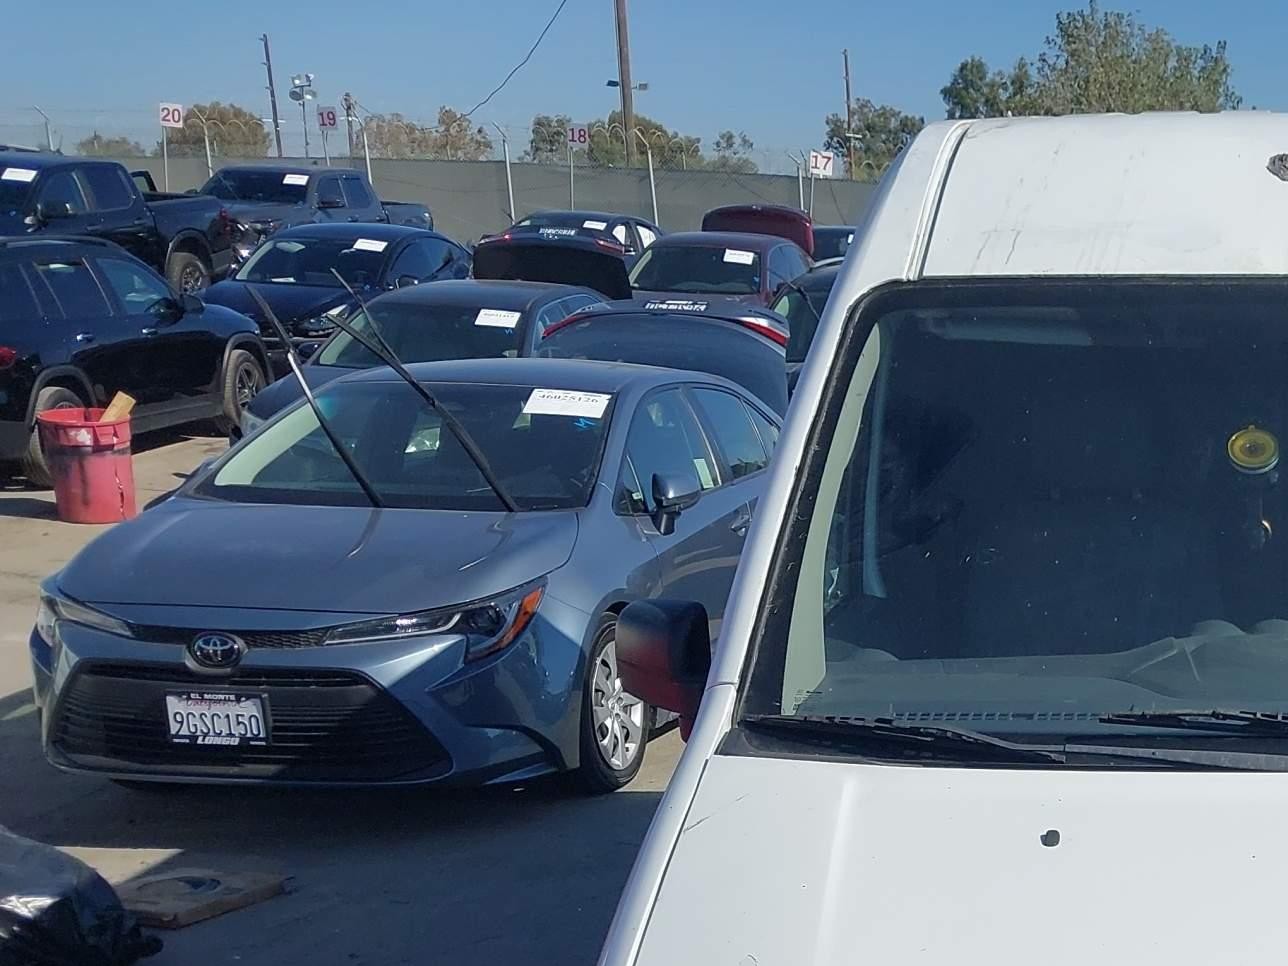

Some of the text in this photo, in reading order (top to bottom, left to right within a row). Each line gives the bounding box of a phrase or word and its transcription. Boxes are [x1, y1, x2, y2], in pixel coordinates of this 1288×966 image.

[161, 107, 181, 123] 20
[318, 111, 336, 126] 19
[568, 128, 586, 143] 18
[811, 154, 832, 170] 17
[173, 711, 261, 737] 9GSC150
[197, 736, 240, 745] LONGO
